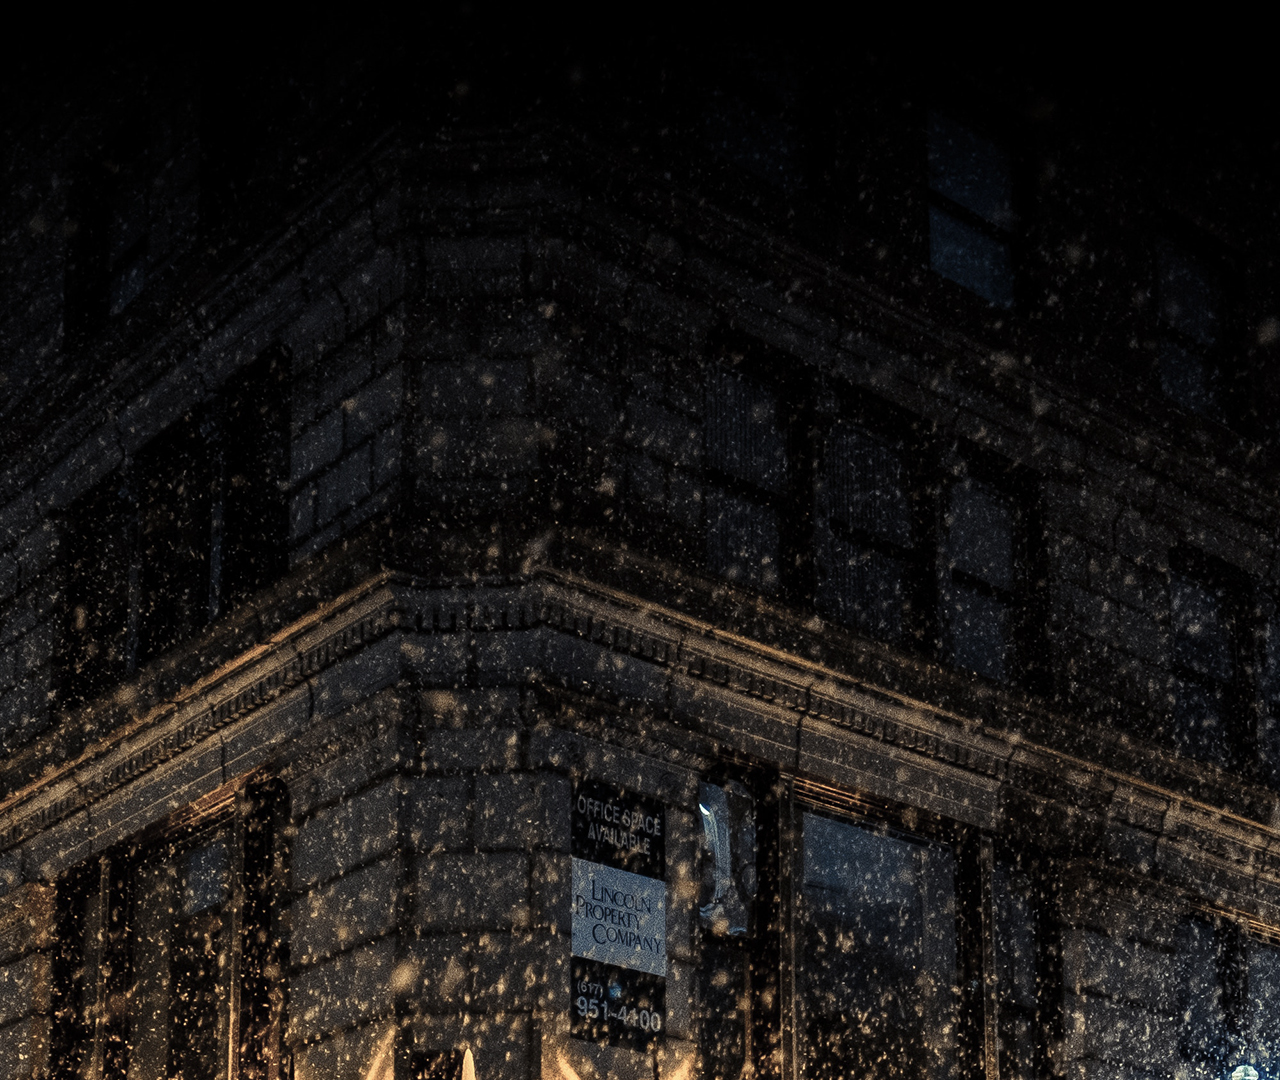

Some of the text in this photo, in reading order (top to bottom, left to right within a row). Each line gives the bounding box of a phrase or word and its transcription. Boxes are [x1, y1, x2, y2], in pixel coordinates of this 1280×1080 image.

[577, 795, 661, 836] OFFICE SPACE
[588, 822, 651, 855] AVAILABLE
[575, 895, 640, 930] PROPERTY
[591, 880, 652, 914] LINCOLN
[592, 923, 661, 953] COMPANY
[577, 980, 604, 998] (617)
